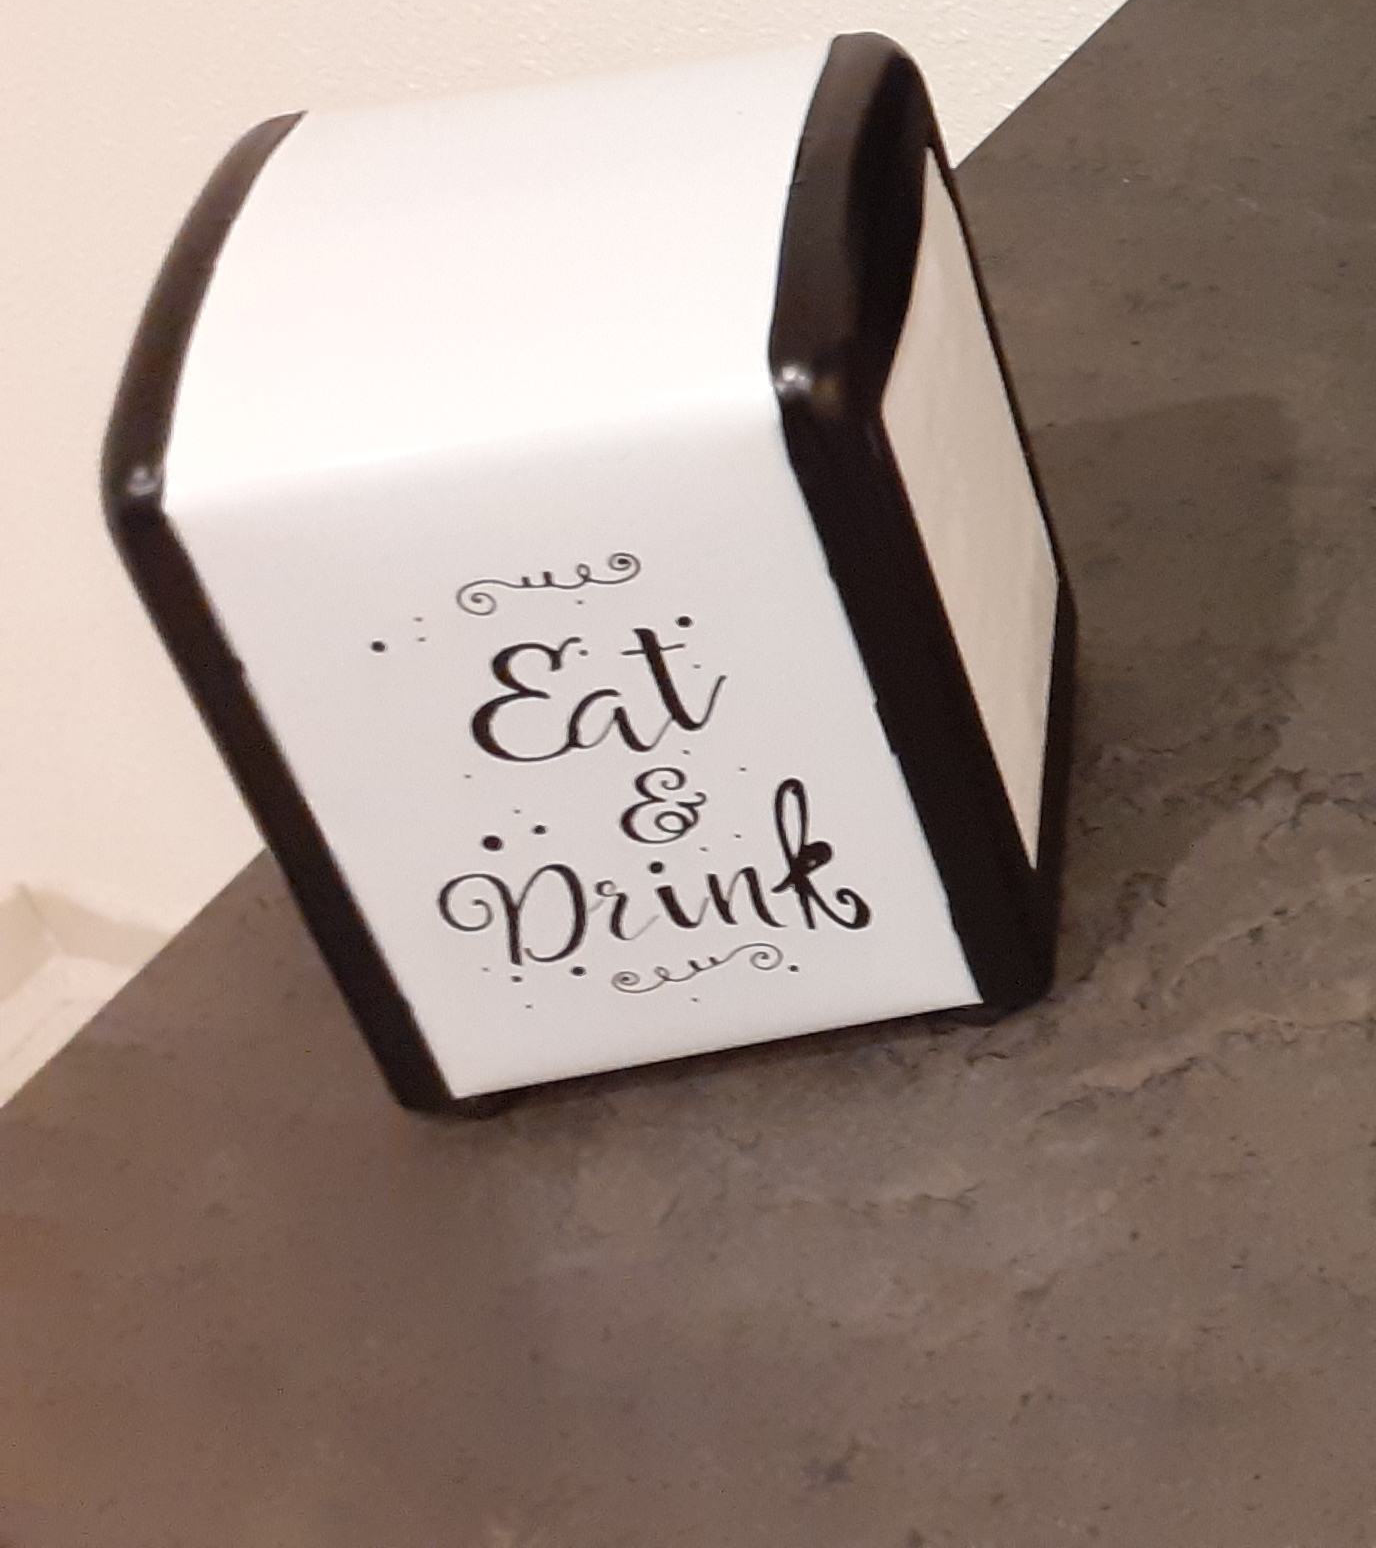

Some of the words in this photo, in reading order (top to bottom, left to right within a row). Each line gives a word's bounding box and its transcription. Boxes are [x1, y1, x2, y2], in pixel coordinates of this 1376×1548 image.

[471, 627, 727, 763] Eat
[437, 777, 871, 967] Drink
[619, 766, 707, 845] &
